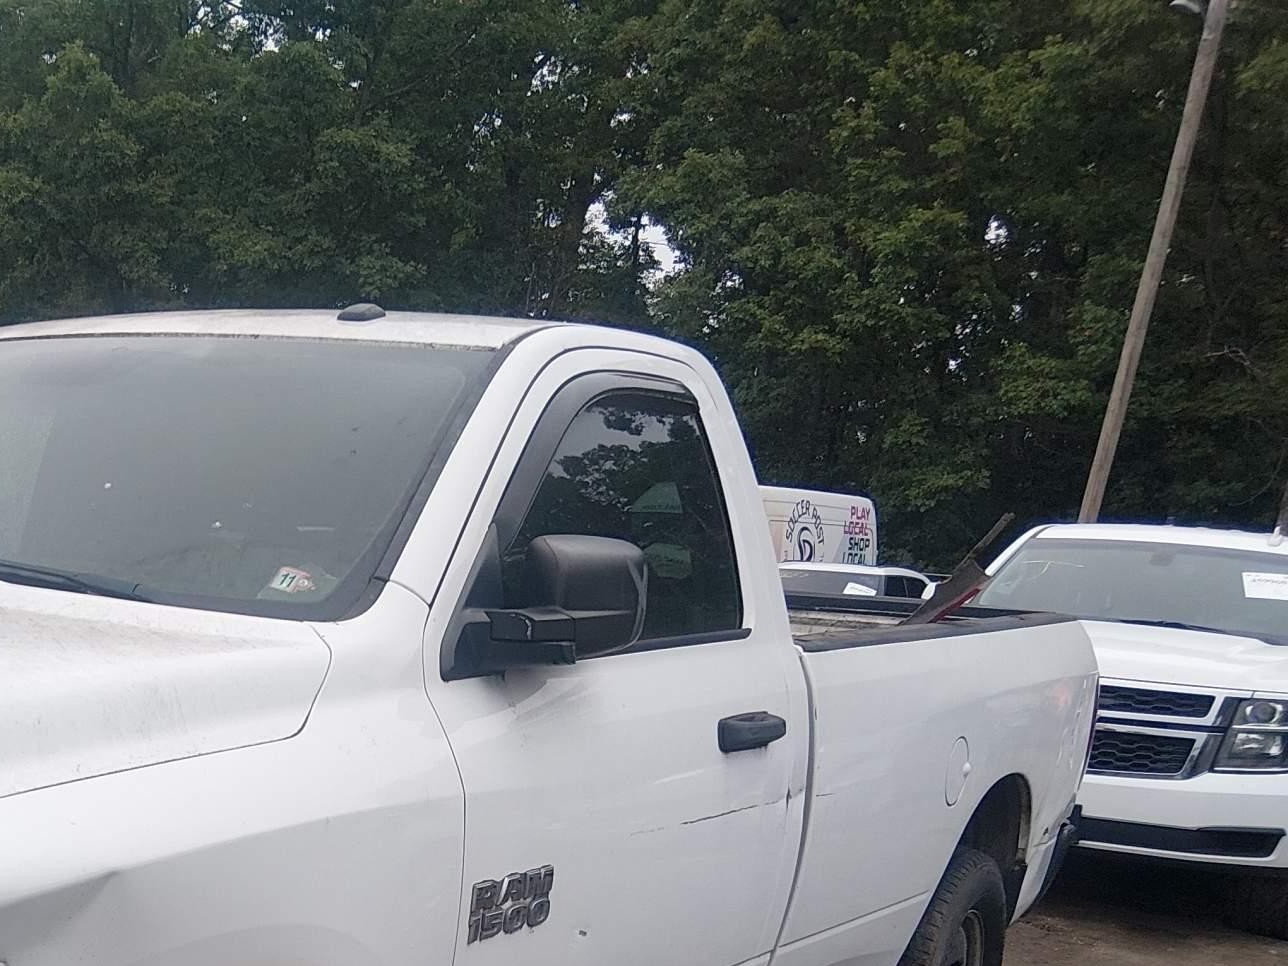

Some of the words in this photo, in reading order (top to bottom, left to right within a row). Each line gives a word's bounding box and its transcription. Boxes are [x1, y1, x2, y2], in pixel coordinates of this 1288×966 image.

[850, 505, 871, 521] PLAY
[785, 499, 811, 543] SOCCER
[811, 506, 825, 545] POST
[843, 520, 869, 536] LOCAL
[847, 536, 871, 552] SHOP
[279, 572, 297, 588] 11
[470, 863, 555, 911] RAM
[467, 897, 551, 945] 1500
